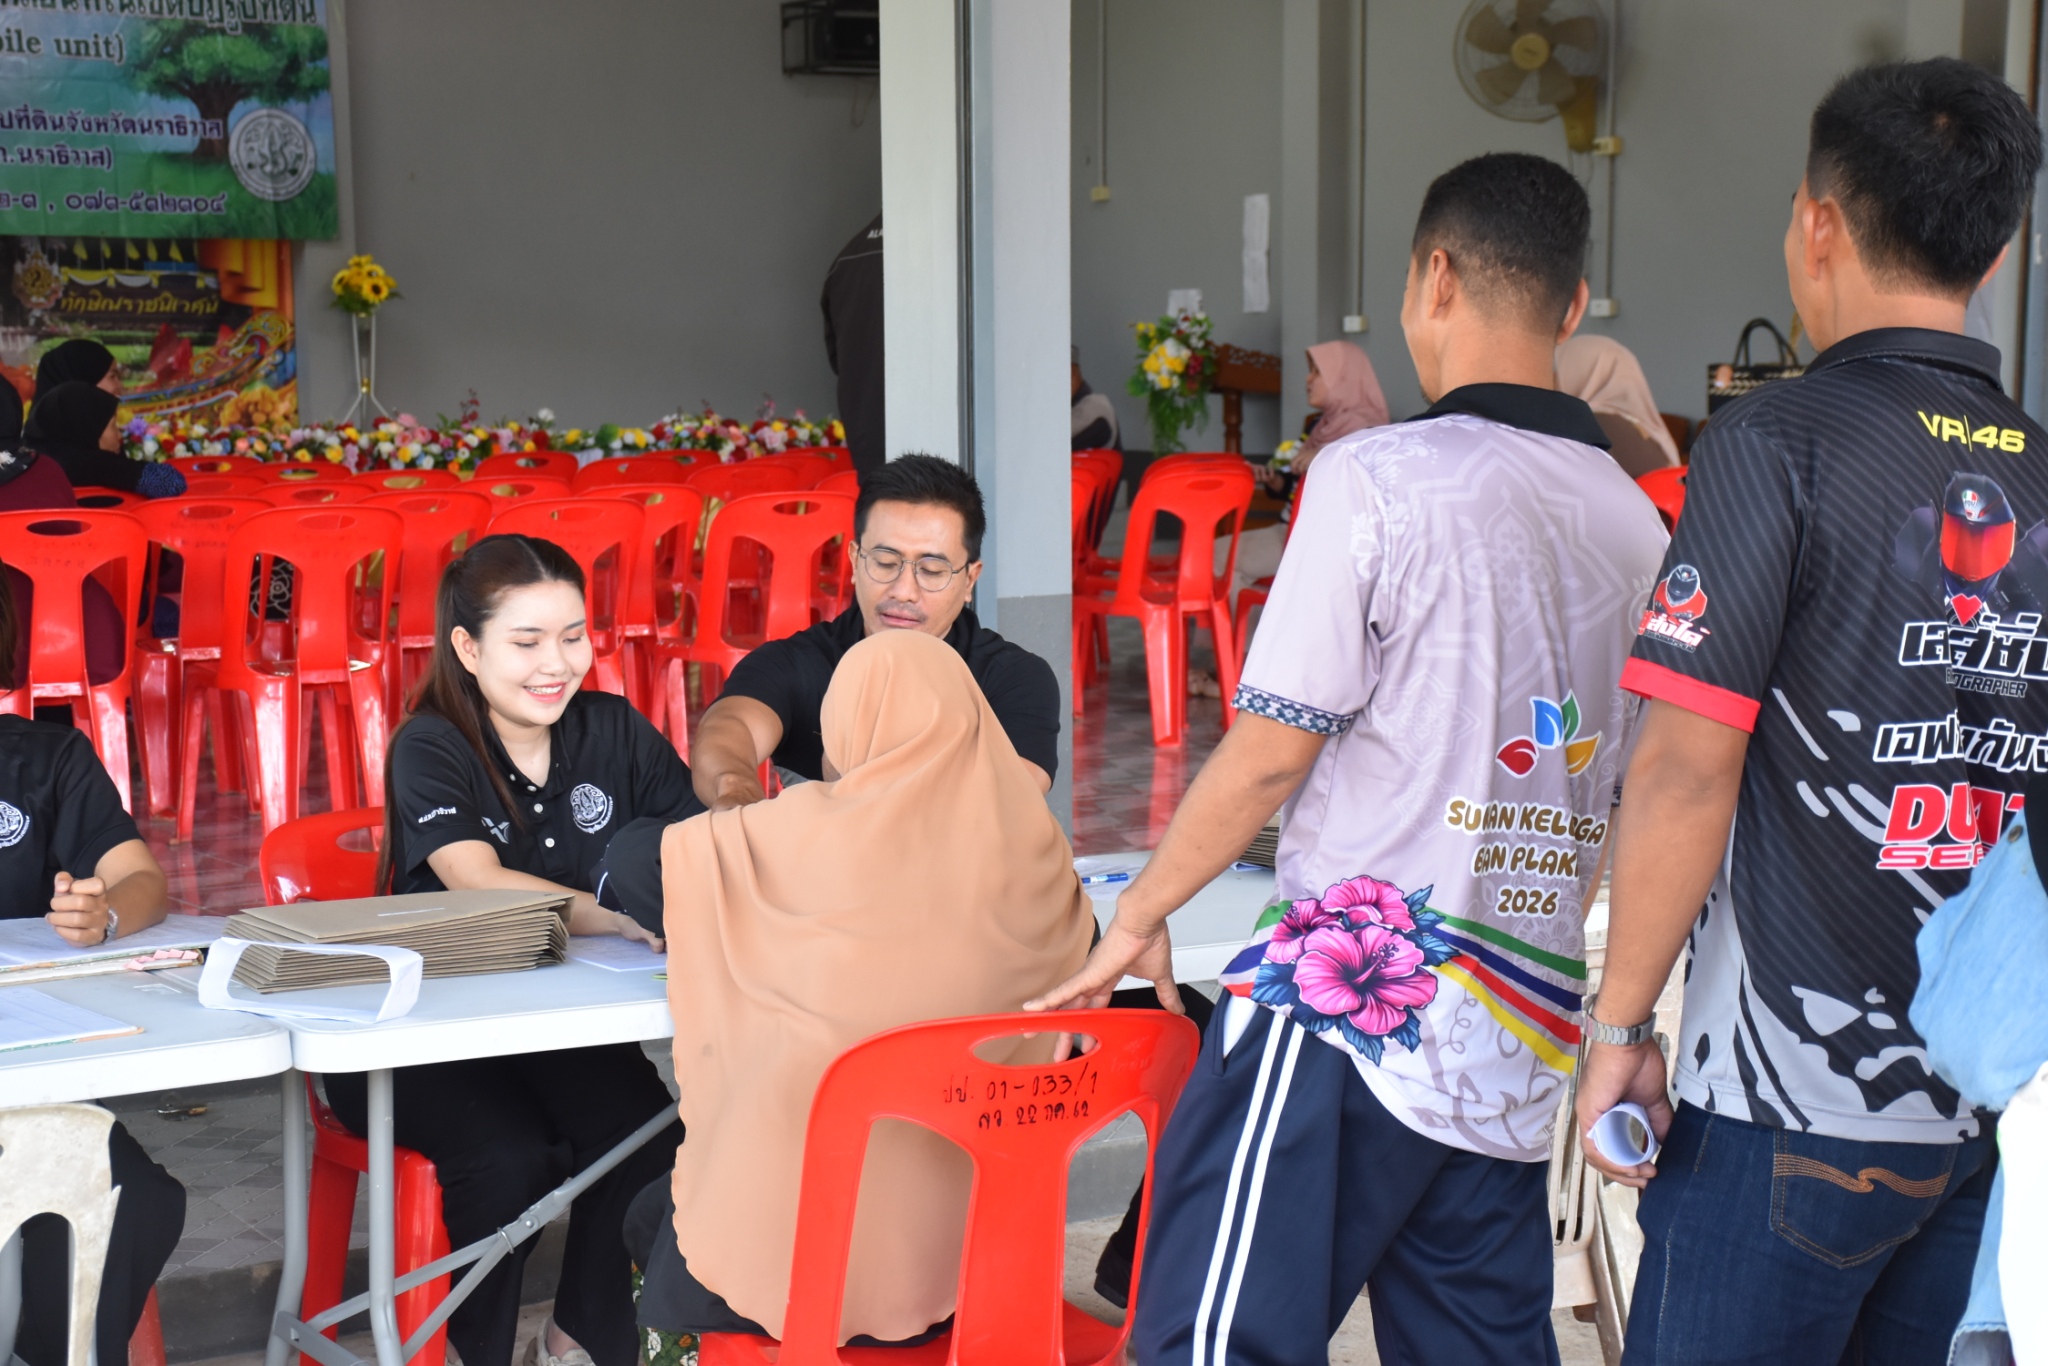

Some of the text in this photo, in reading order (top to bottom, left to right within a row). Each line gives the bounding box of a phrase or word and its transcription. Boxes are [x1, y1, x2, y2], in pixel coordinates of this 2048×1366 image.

[0, 27, 125, 63] ile unit)
[1509, 846, 1579, 878] PLAK
[1497, 888, 1558, 916] 2026
[1016, 1104, 1037, 1125] 22
